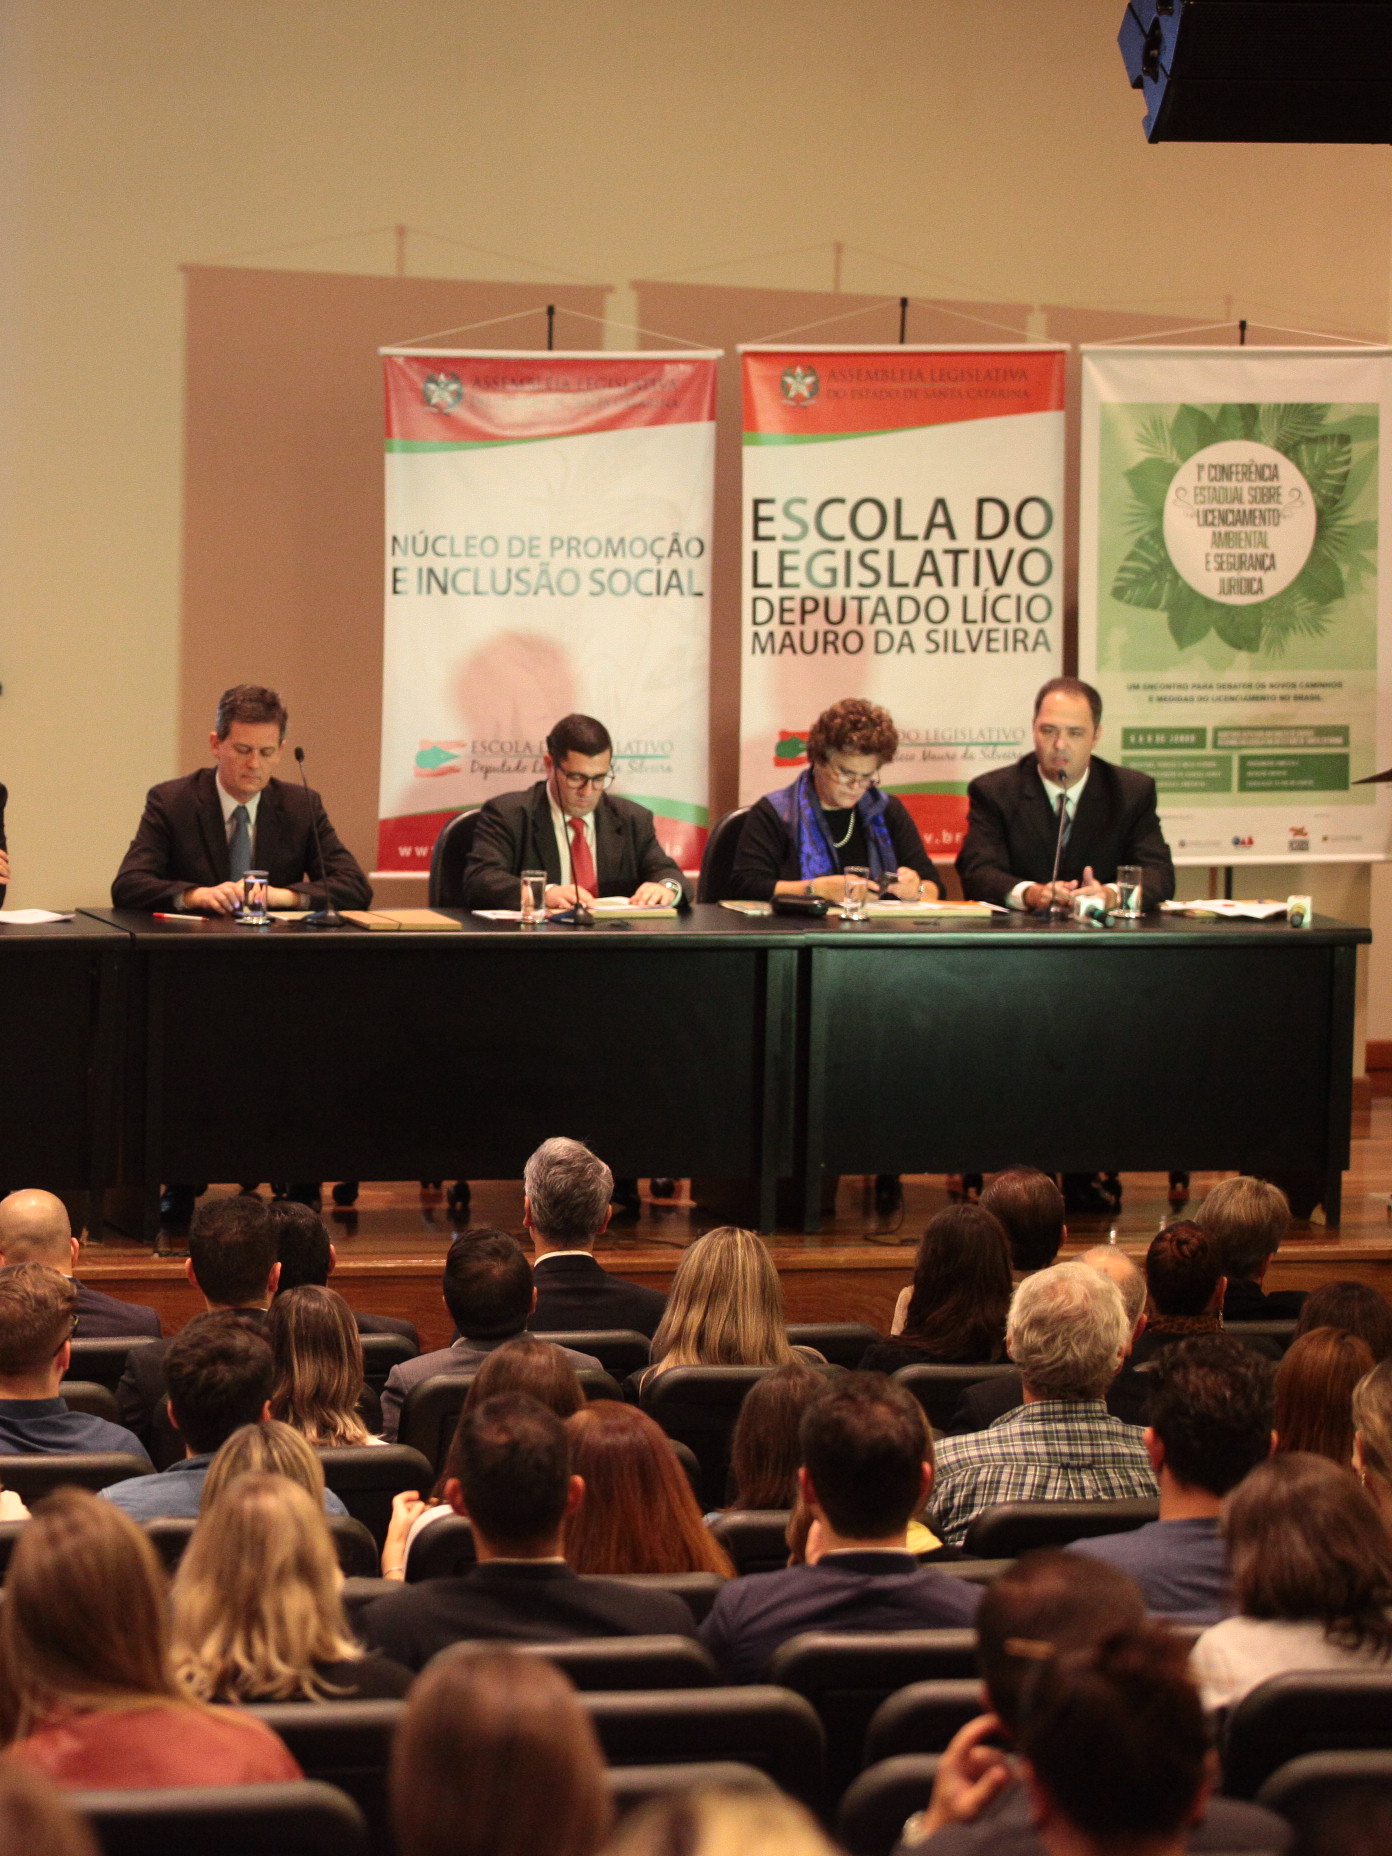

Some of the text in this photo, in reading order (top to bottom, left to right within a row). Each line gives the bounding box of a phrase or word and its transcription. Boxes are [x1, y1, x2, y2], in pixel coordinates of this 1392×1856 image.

[828, 368, 1028, 382] ASSEMBLEIA LEGISLATIVA
[966, 388, 1028, 400] CATARINA
[1208, 458, 1279, 482] CONFERÊNCIA
[1194, 486, 1282, 505] ESTADUAL SOBRE
[753, 496, 1054, 542] ESCOLA DO
[1196, 508, 1280, 527] LICENCIAMENTO
[392, 530, 705, 564] NÚCLEO DE PROMOÇÃO
[1210, 530, 1269, 549] AMBIENTAL
[752, 547, 1054, 589] LEGISLATIVO
[1214, 553, 1276, 575] SEGURANÇA
[392, 562, 704, 596] E INCLUSÃO SOCIAL
[1218, 573, 1264, 596] JURÍDICA
[752, 587, 1053, 626] DEPUTADO LÍCIO
[751, 629, 1051, 655] MAURO DA SILVEIRA
[1142, 682, 1189, 690] ENCONTRO
[1191, 682, 1214, 690] PARA
[1269, 681, 1297, 690] NOVOS
[1299, 680, 1343, 689] CAMINHOS
[1156, 694, 1195, 702] MEDIDAS
[1211, 694, 1277, 702] LICENCIAMENTO
[926, 727, 1025, 741] LEGISLATIVO
[471, 739, 533, 754] ESCOLA
[470, 759, 528, 780] Deputado
